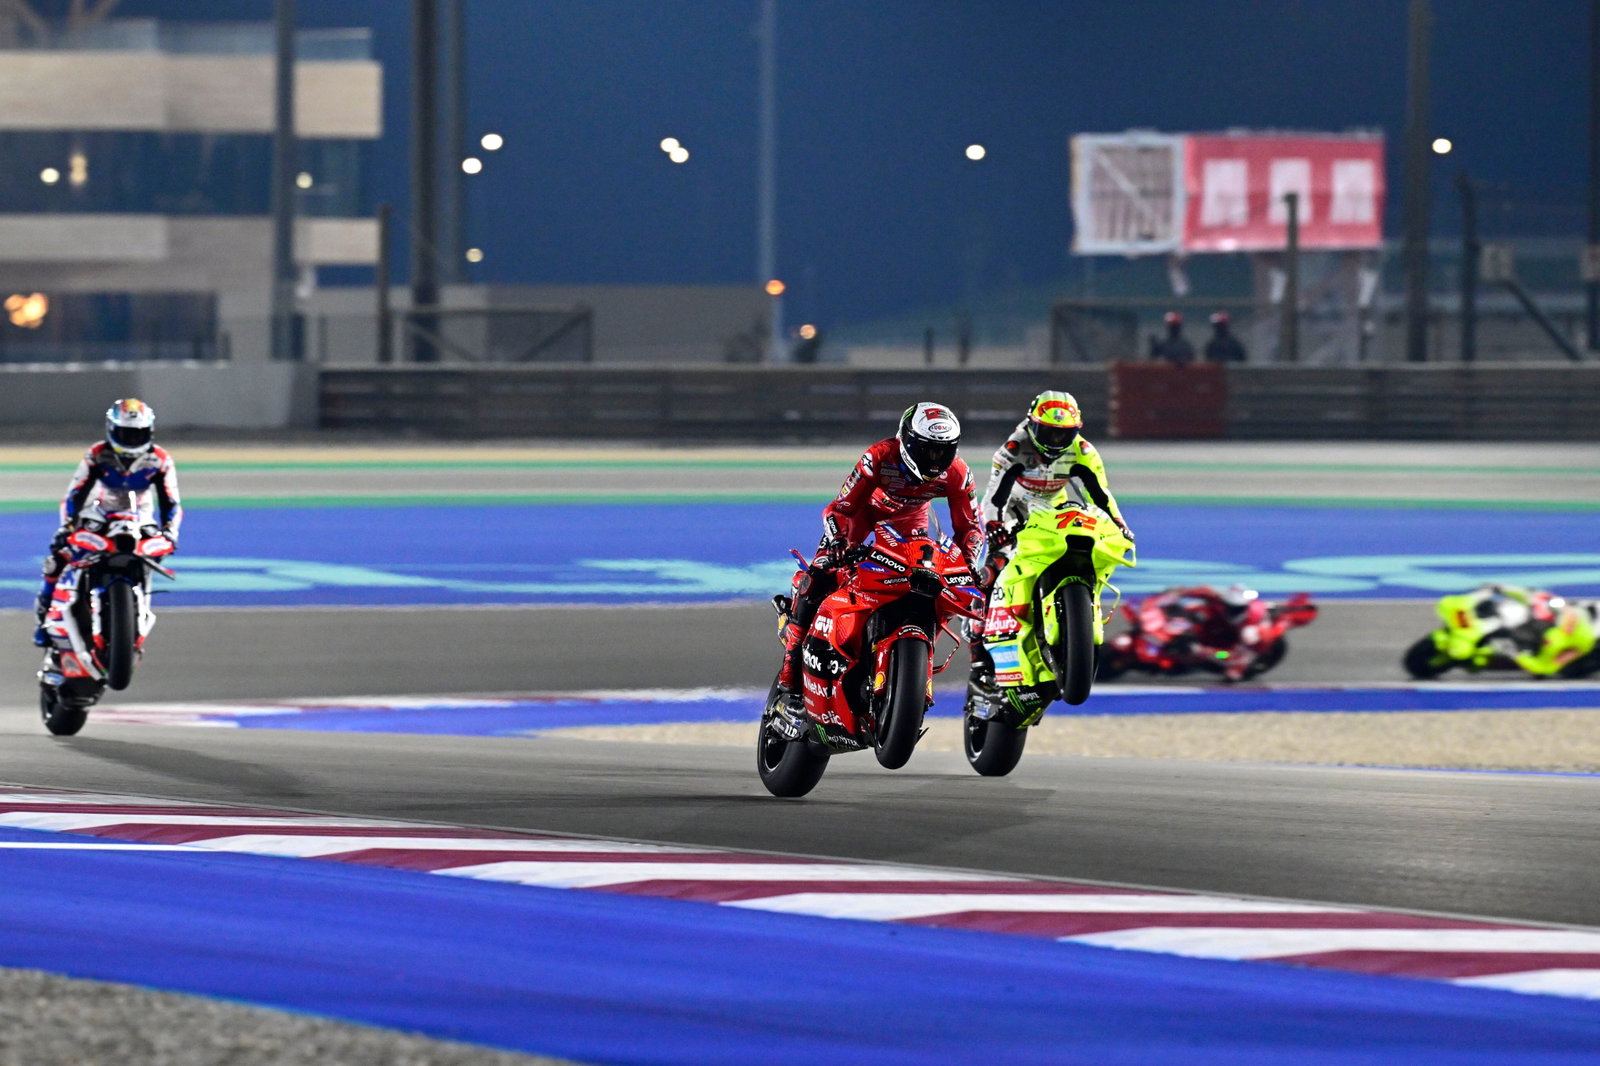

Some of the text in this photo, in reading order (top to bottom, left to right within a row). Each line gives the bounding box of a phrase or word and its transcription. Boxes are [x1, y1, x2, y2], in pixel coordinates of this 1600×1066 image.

[1055, 510, 1097, 531] 72
[870, 551, 906, 573] Lenovo
[916, 544, 936, 569] 1
